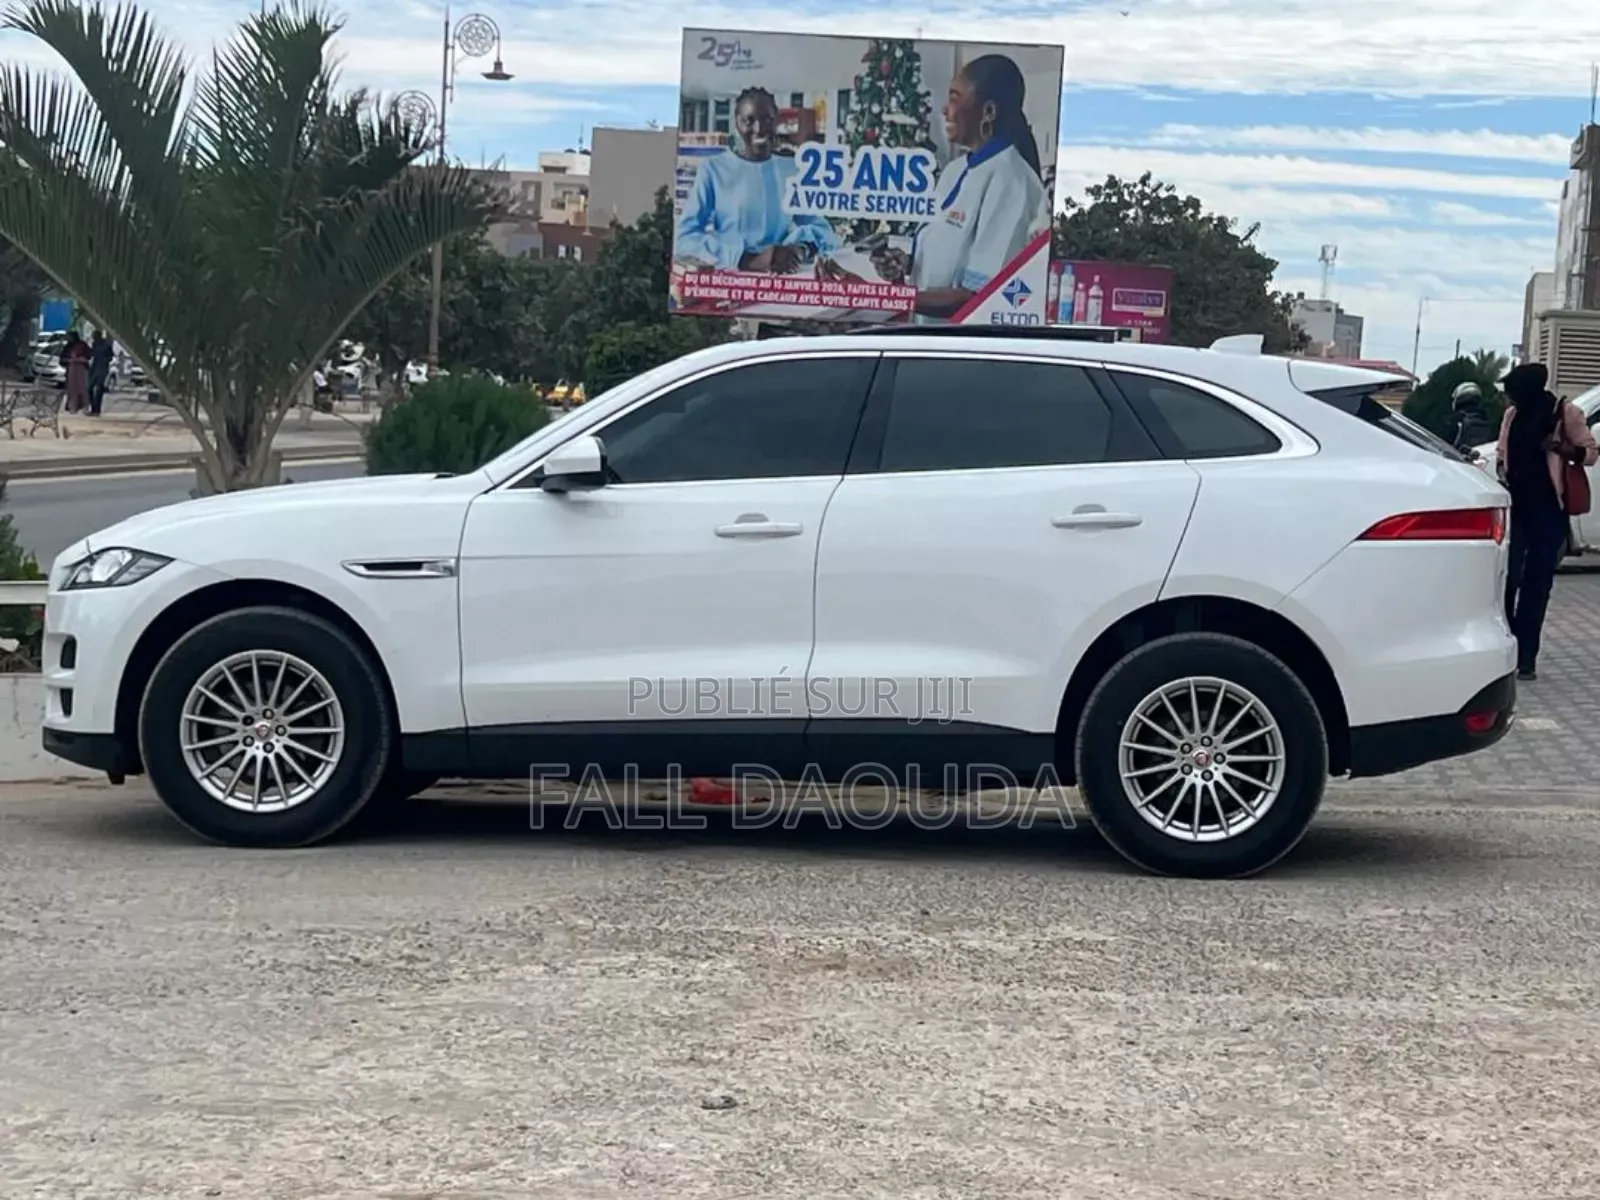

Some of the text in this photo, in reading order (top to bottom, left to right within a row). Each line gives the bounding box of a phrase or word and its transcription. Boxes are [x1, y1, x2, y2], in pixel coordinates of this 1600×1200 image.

[801, 148, 930, 193] 25 ANS
[789, 183, 936, 216] À VOTRE SERVICE
[685, 274, 699, 285] DU
[712, 272, 758, 287] DÉCEMBRE
[759, 278, 772, 288] AU
[784, 280, 820, 292] JANVIER
[847, 283, 877, 295] FAITES
[878, 285, 888, 296] LE
[890, 286, 917, 297] PLEIN
[731, 288, 742, 299] ET
[743, 289, 755, 300] DE
[757, 291, 797, 303] CADEAUX
[798, 293, 821, 304] AVEC
[822, 295, 850, 306] VOTRE
[852, 297, 880, 308] CARTE
[882, 298, 908, 310] OASIS
